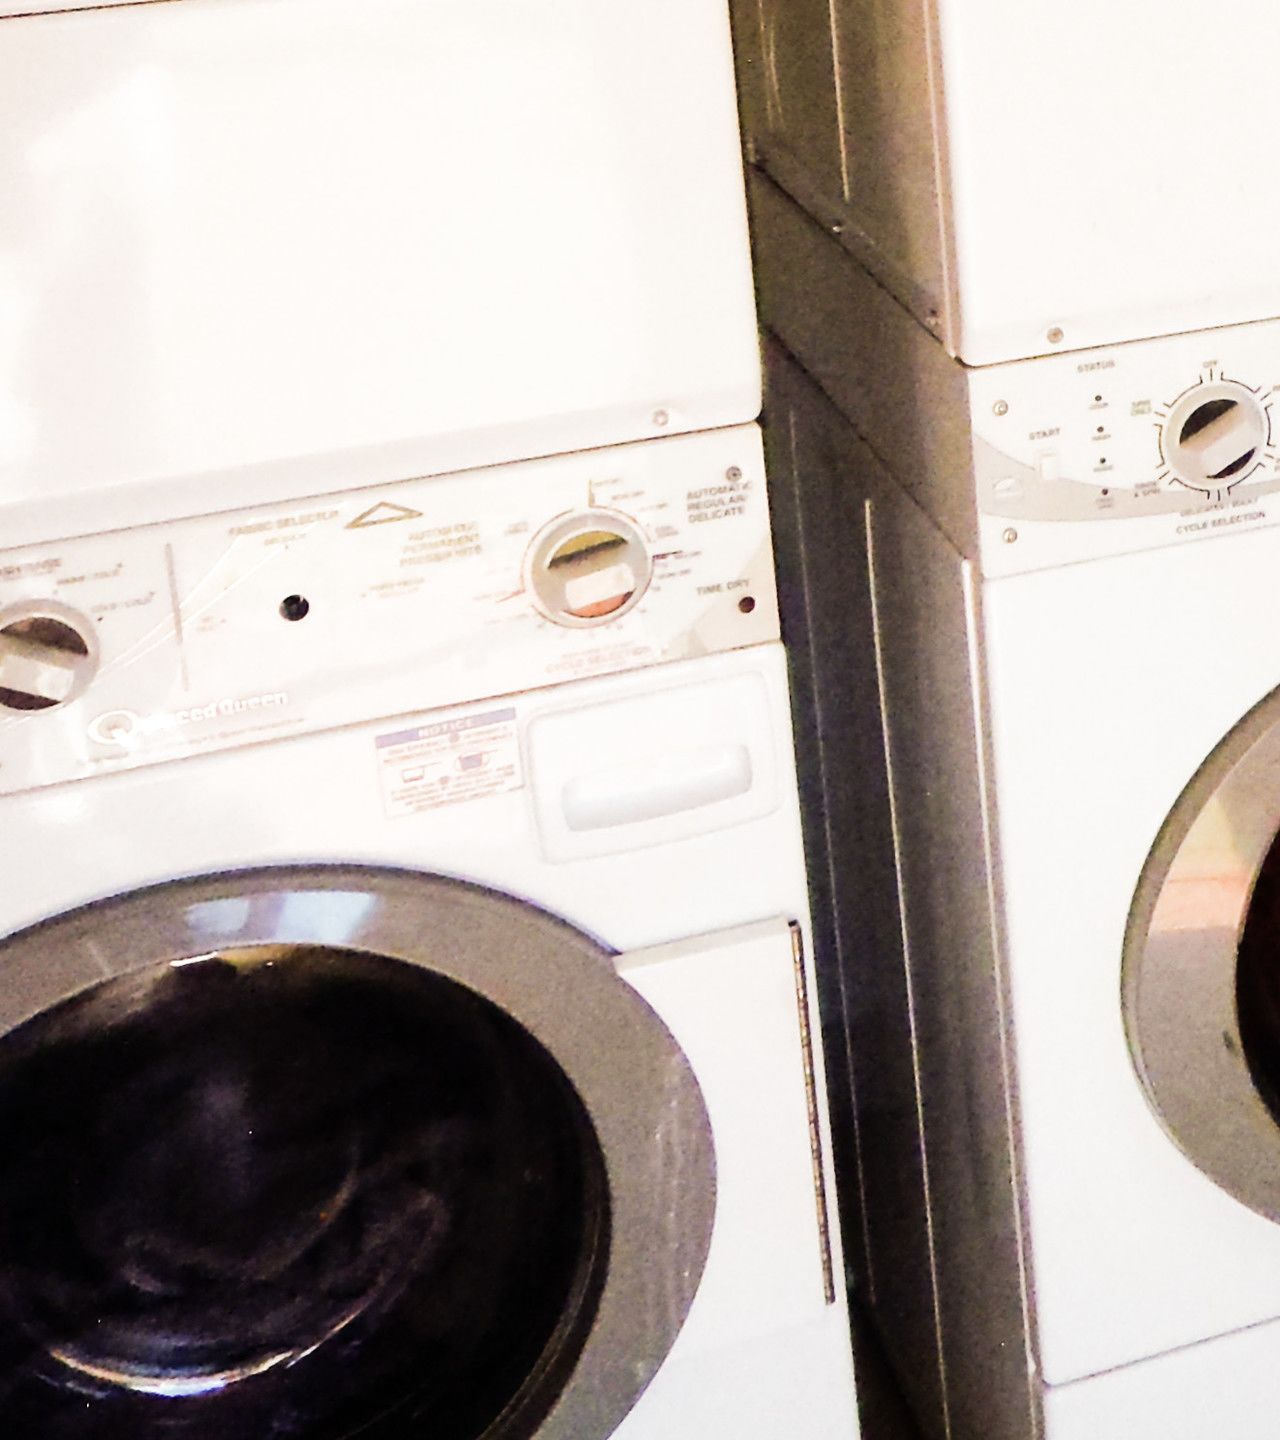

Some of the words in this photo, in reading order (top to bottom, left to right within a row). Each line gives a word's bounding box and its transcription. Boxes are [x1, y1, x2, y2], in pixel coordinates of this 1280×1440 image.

[1029, 428, 1061, 440] START
[687, 481, 752, 500] AUTOMATIC
[688, 507, 744, 523] DELICATE
[219, 692, 288, 717] Queen
